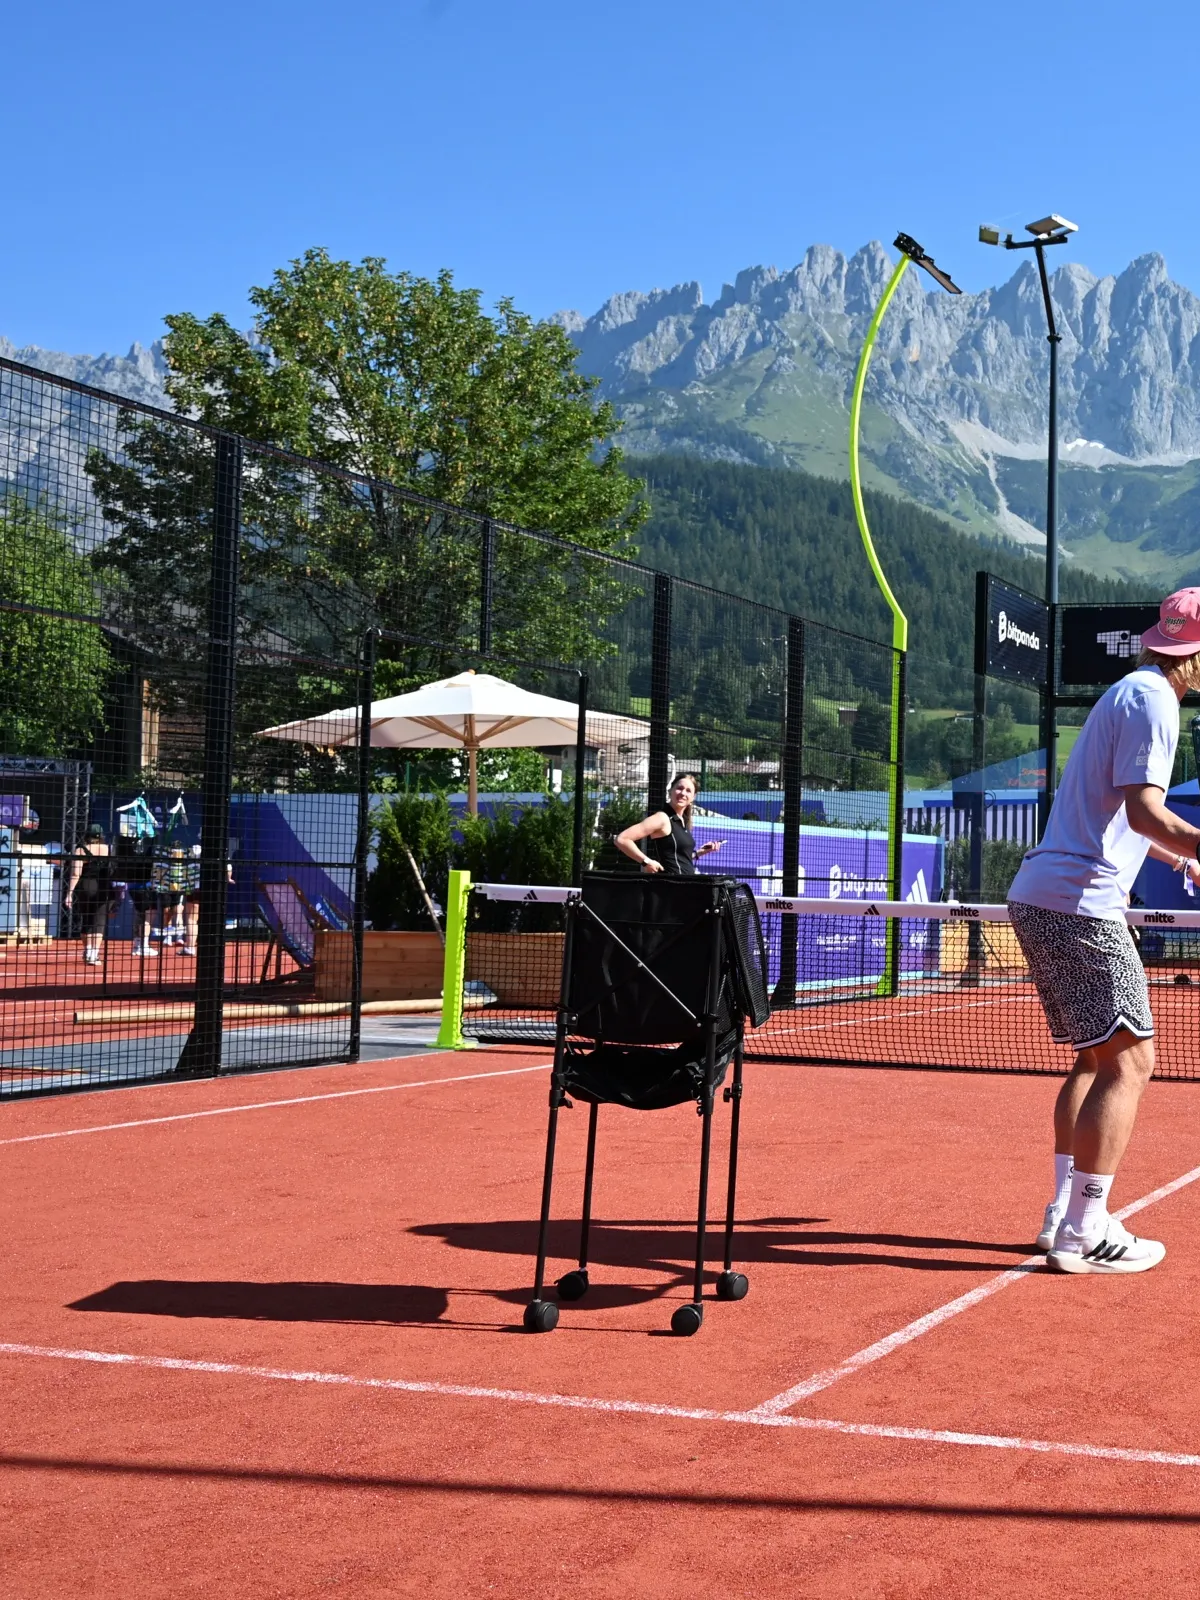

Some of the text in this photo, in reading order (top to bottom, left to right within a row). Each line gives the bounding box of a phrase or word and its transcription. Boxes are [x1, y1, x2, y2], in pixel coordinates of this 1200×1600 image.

[1007, 620, 1040, 650] bitpanda
[765, 898, 794, 911] mitte
[950, 905, 980, 918] mitte
[1144, 911, 1175, 924] mitte
